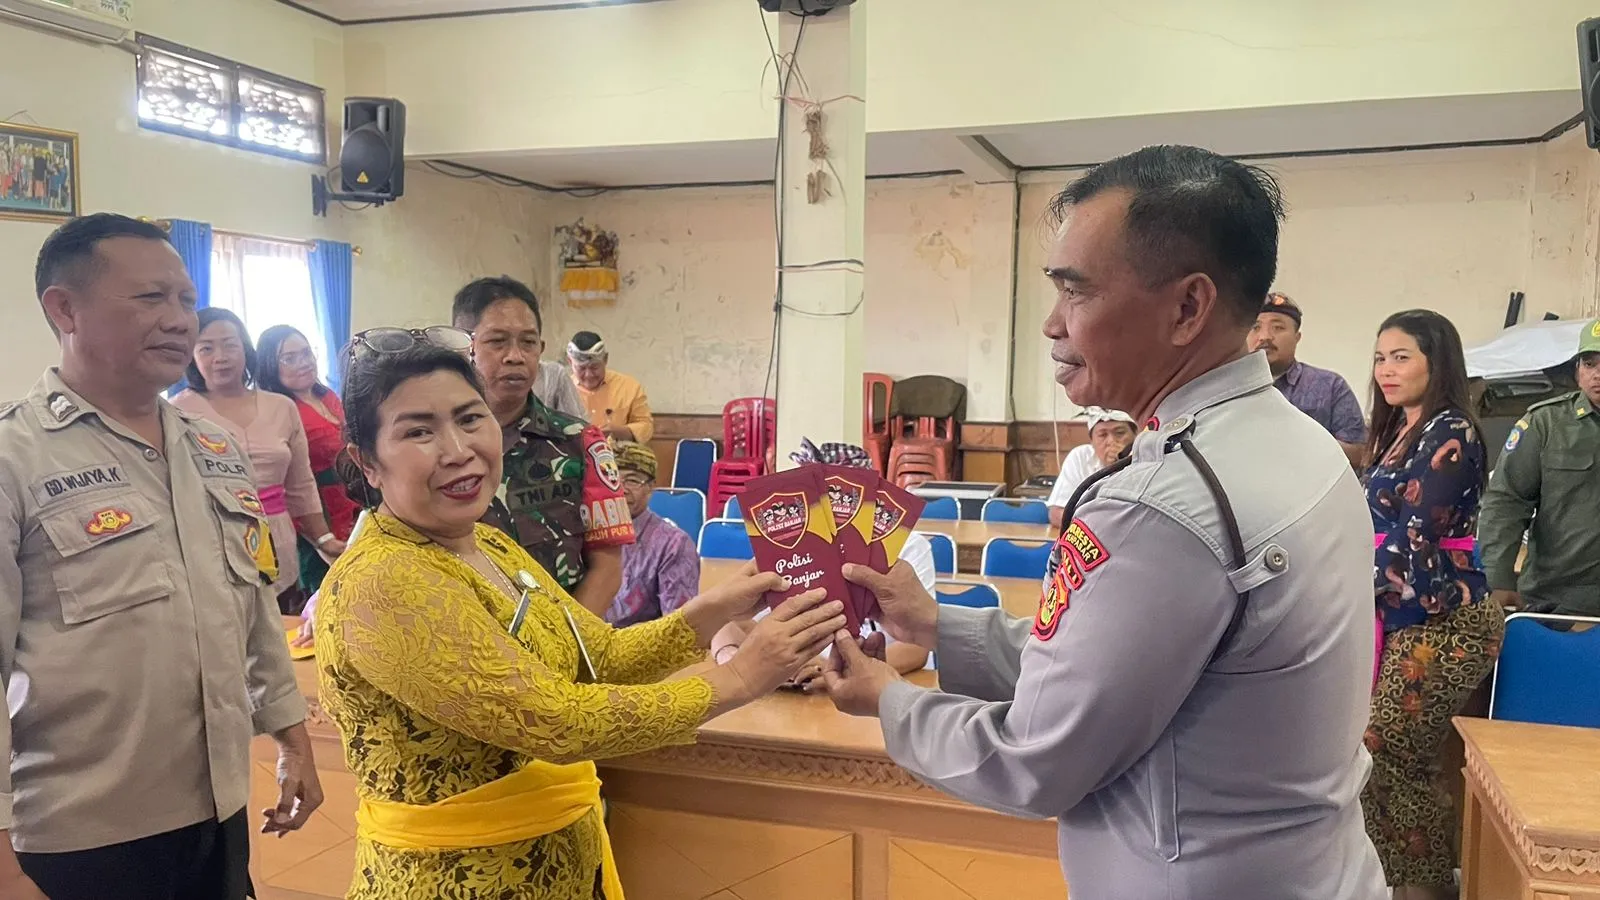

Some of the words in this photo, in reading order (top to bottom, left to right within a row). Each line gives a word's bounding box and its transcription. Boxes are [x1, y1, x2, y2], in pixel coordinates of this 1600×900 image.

[205, 458, 248, 476] POLR
[515, 487, 545, 505] TNI
[552, 483, 572, 498] AD
[775, 553, 813, 573] Polisi
